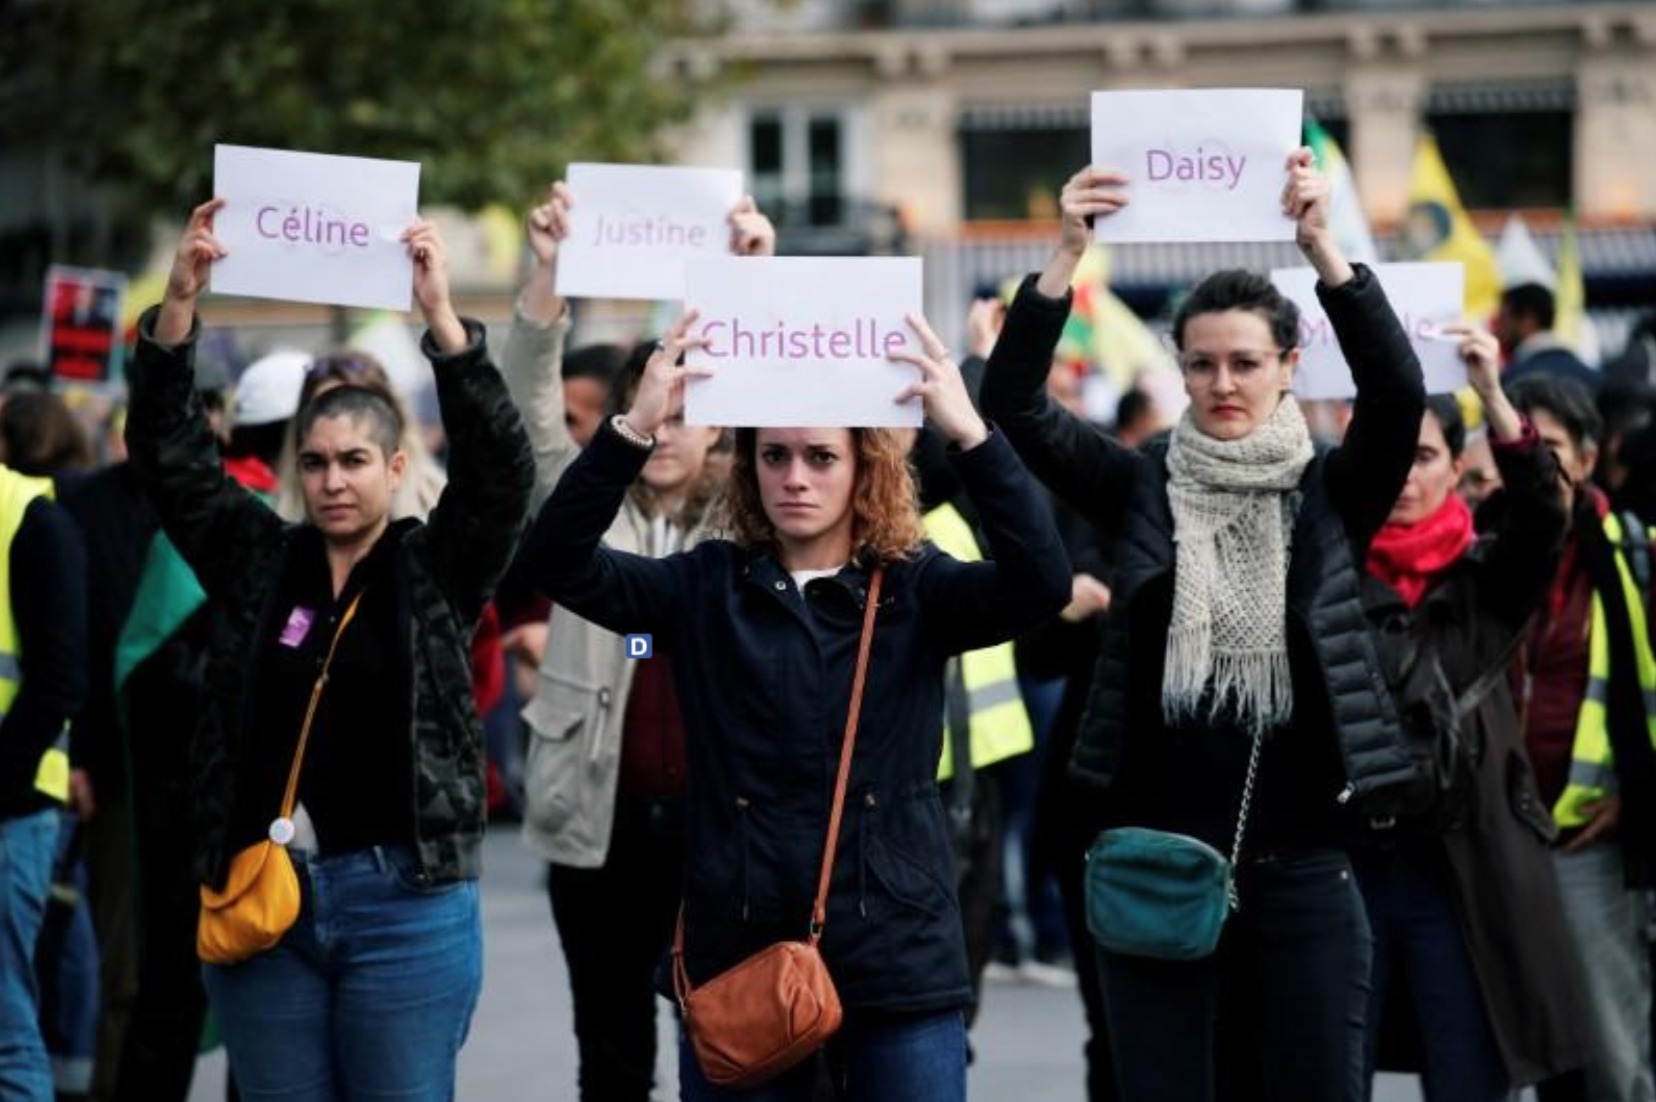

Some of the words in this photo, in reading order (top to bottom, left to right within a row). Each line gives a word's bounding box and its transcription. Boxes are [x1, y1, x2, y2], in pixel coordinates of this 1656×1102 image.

[1146, 146, 1246, 190] Daisy
[256, 205, 370, 247] Céline
[592, 214, 706, 247] Justine
[701, 317, 907, 359] Christelle
